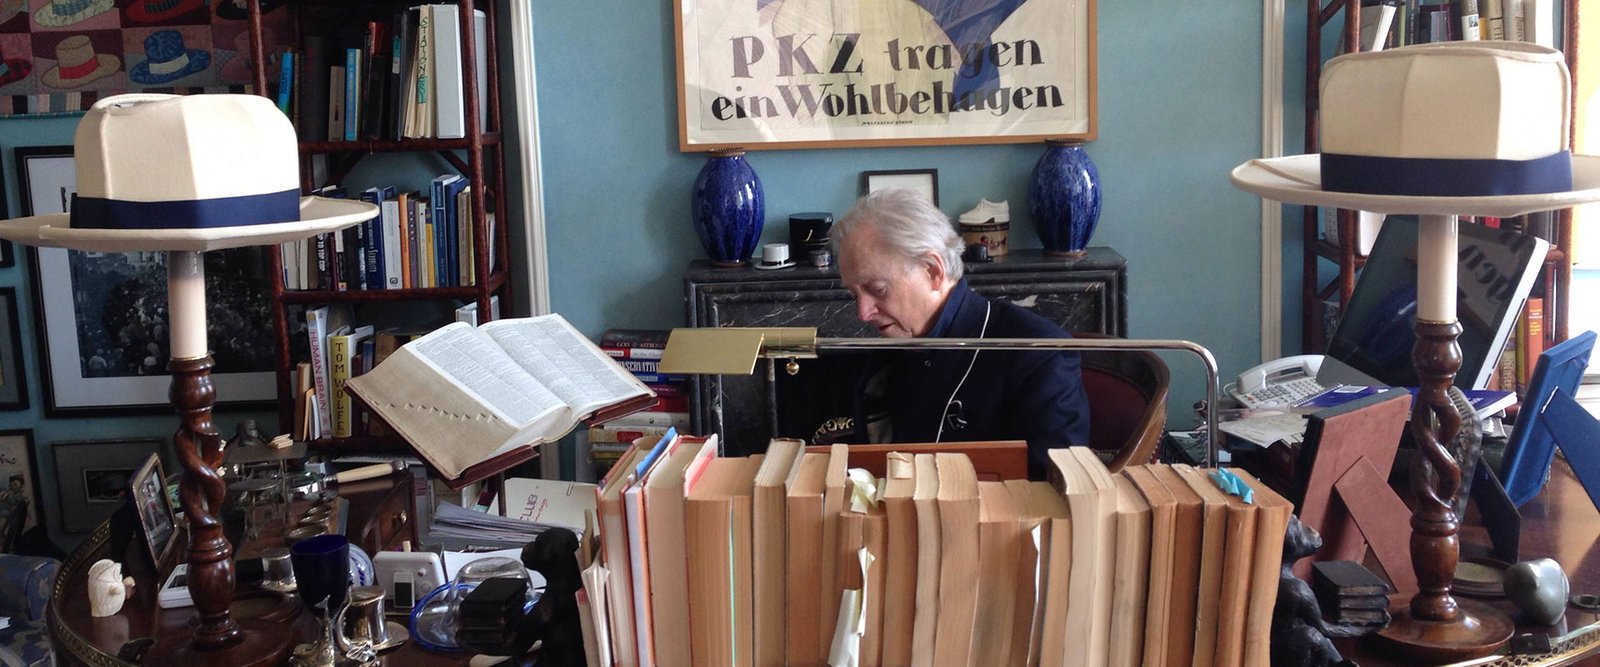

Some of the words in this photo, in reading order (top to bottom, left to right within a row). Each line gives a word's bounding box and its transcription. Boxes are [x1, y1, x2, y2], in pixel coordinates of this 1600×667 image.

[729, 31, 864, 79] PKZ
[883, 37, 1045, 78] tragen
[310, 328, 321, 374] HUMAN
[316, 376, 327, 411] BRAIN
[335, 342, 345, 374] TOM
[334, 379, 346, 432] WOLFE
